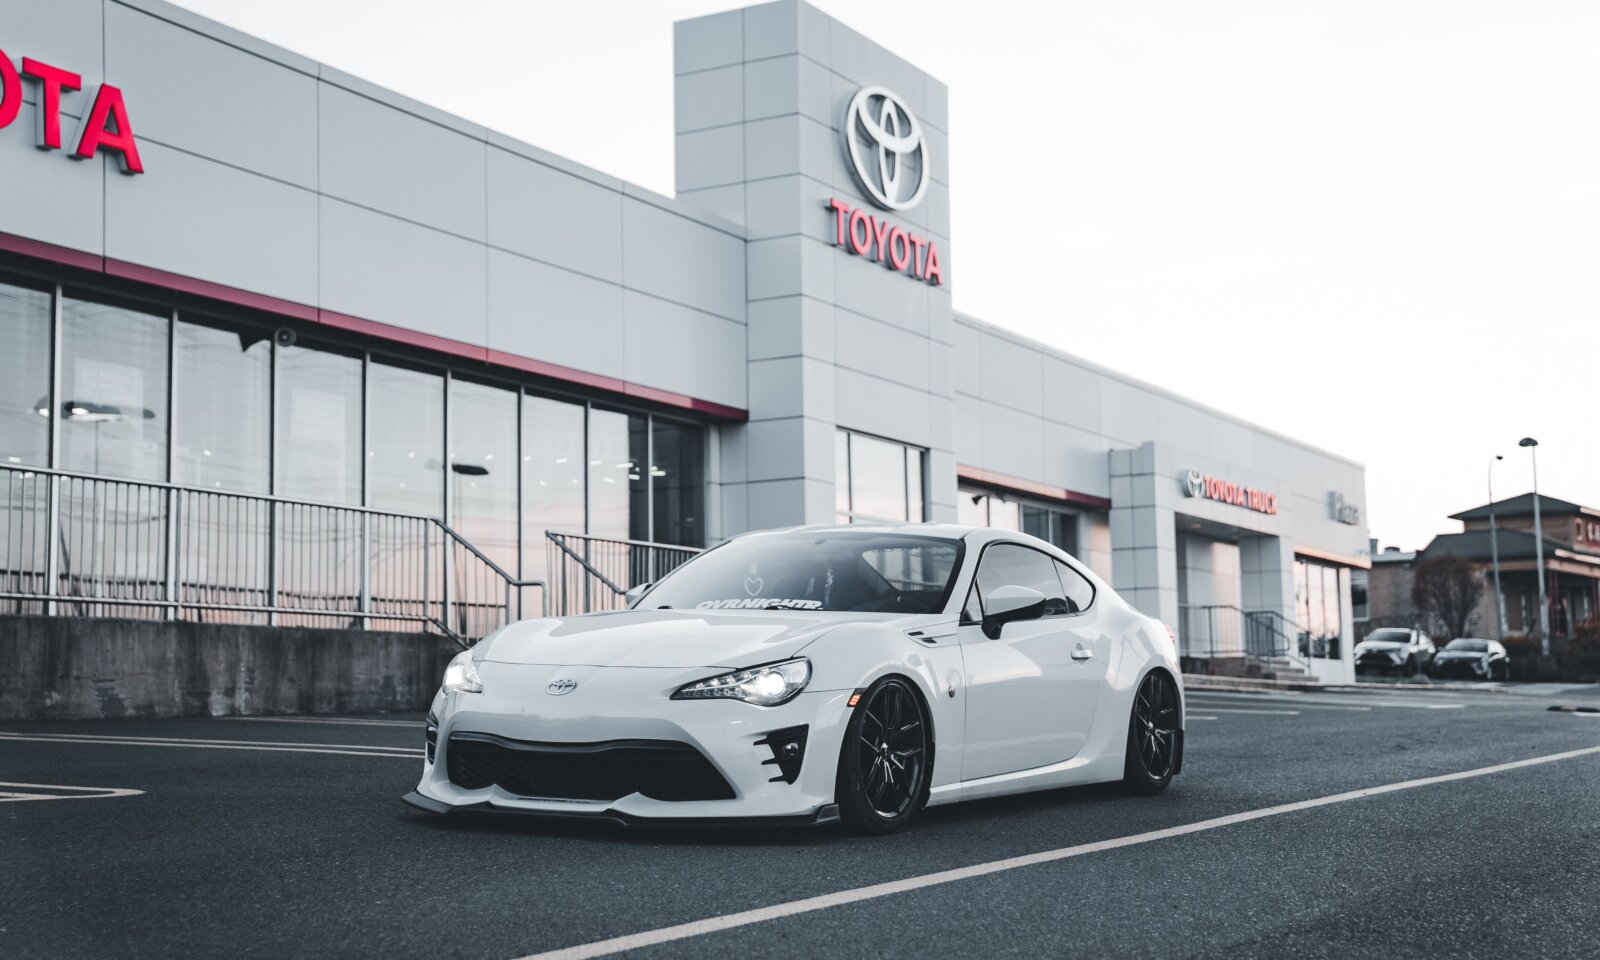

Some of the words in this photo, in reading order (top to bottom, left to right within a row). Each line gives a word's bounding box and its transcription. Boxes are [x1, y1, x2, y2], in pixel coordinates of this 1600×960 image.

[829, 197, 943, 285] TOYOTA
[1203, 475, 1245, 506] TOYOTA
[1246, 487, 1278, 516] TRUCK
